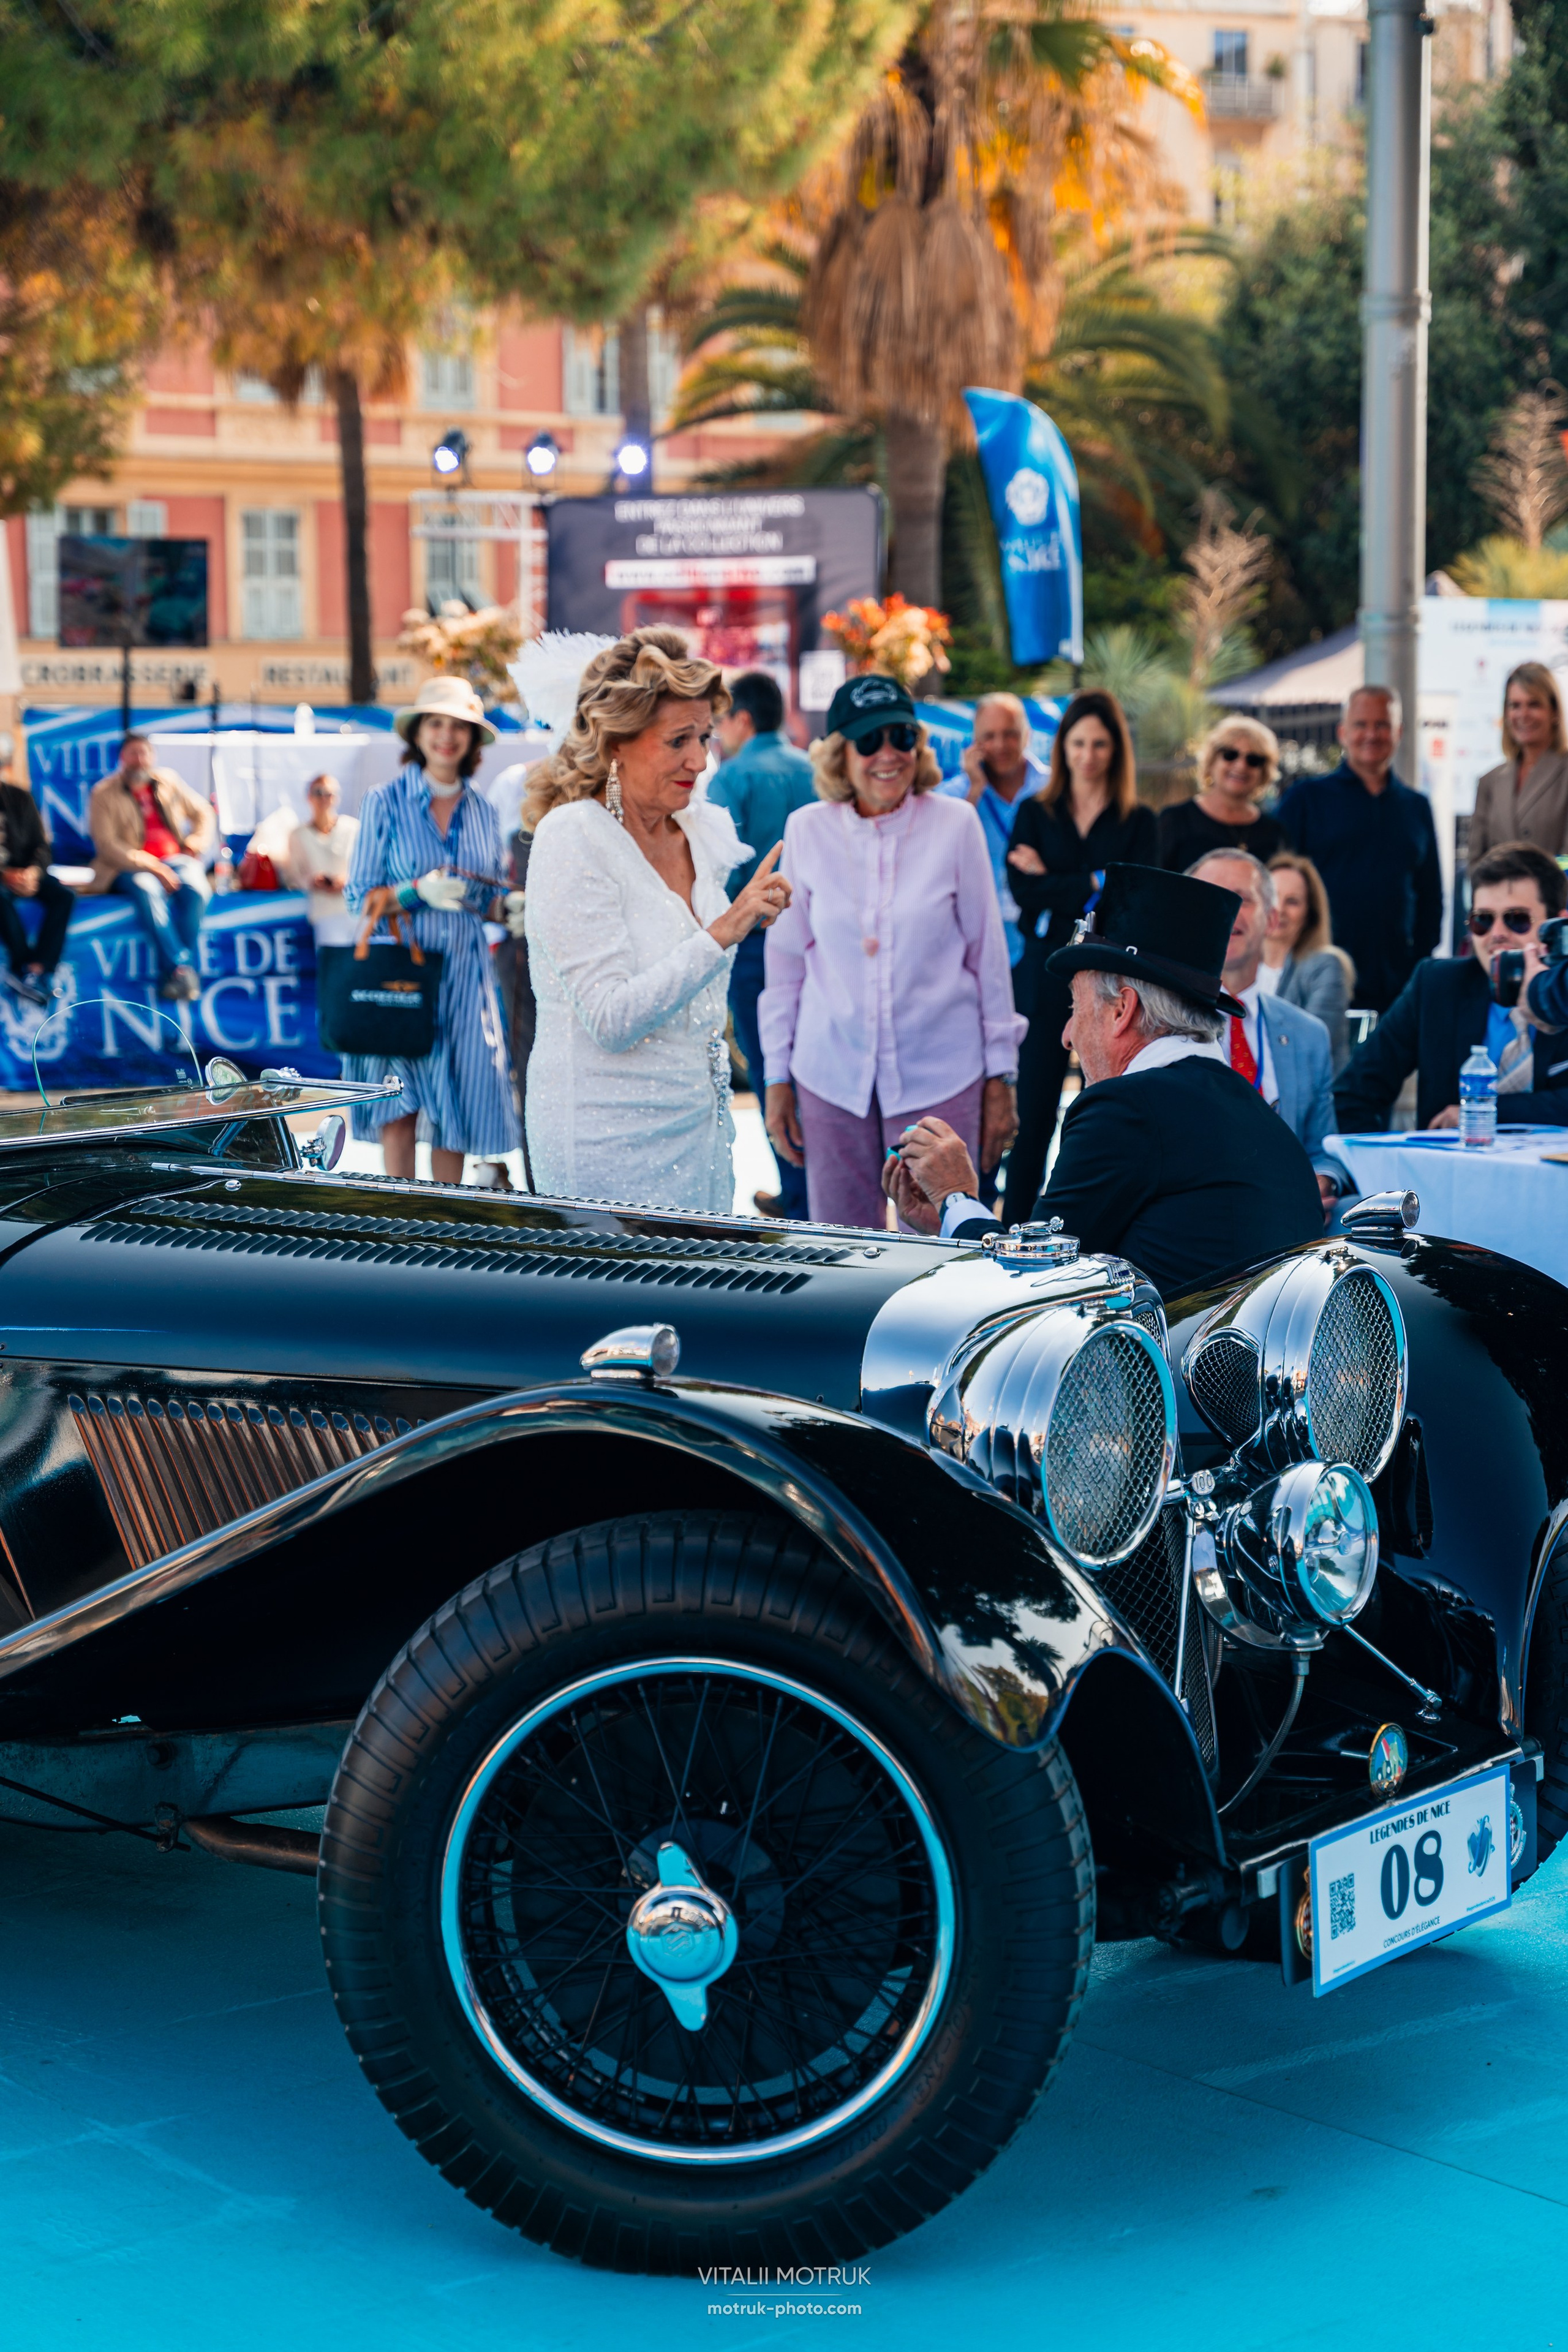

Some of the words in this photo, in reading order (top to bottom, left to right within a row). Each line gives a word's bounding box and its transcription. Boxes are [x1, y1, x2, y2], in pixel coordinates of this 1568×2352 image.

[234, 928, 300, 976] DE
[97, 975, 303, 1059] NICE
[1194, 1472, 1213, 1491] 100
[1370, 1814, 1415, 1845] LEGENDES
[1417, 1809, 1429, 1826] DE
[1431, 1800, 1451, 1820] NICE
[1381, 1830, 1444, 1921] 08
[1384, 1929, 1411, 1948] CONCOURS
[1411, 1916, 1441, 1936] D'ÉLÉGANCE
